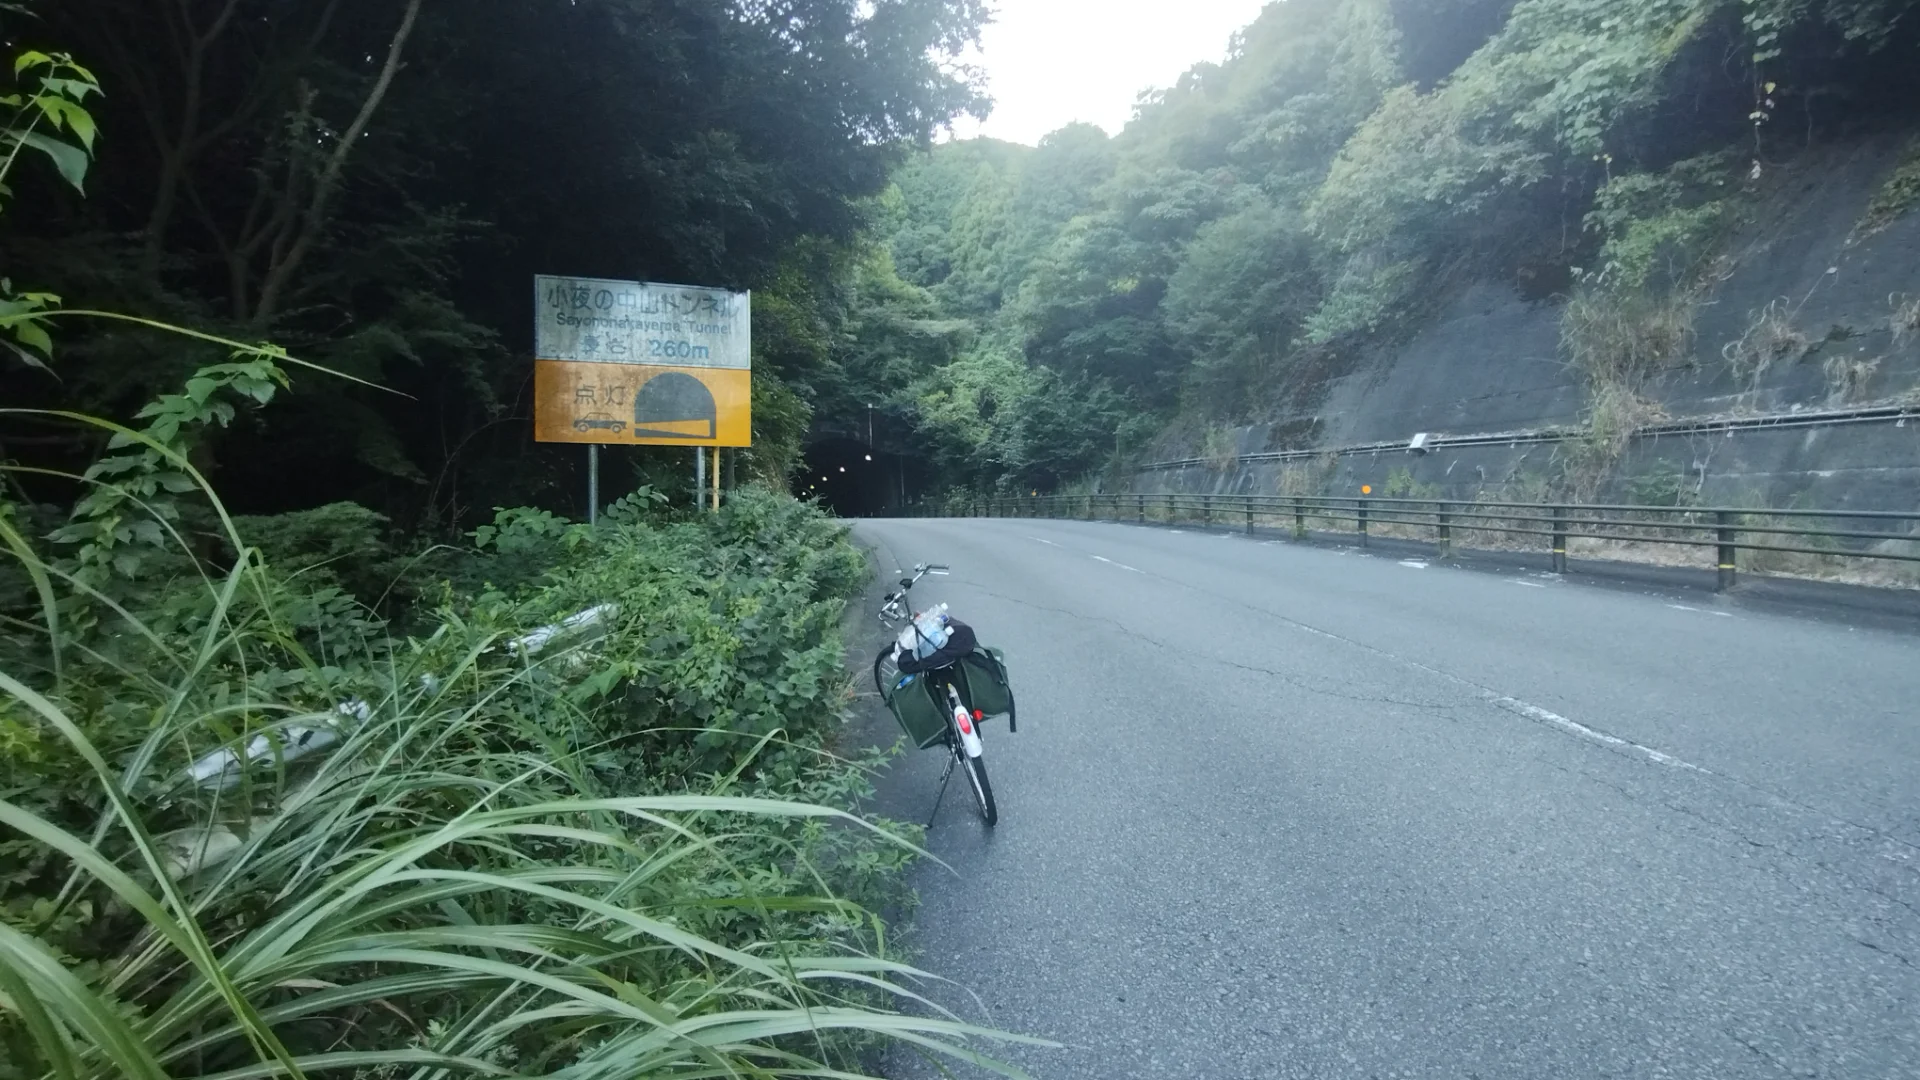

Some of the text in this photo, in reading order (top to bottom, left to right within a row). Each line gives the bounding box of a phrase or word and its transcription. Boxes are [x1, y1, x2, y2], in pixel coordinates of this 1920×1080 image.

[547, 286, 740, 318] 小夜の中山トンネル
[556, 312, 732, 335] Sayononakayama Tunnel
[649, 339, 709, 359] 260m
[574, 384, 625, 406] 点灯
